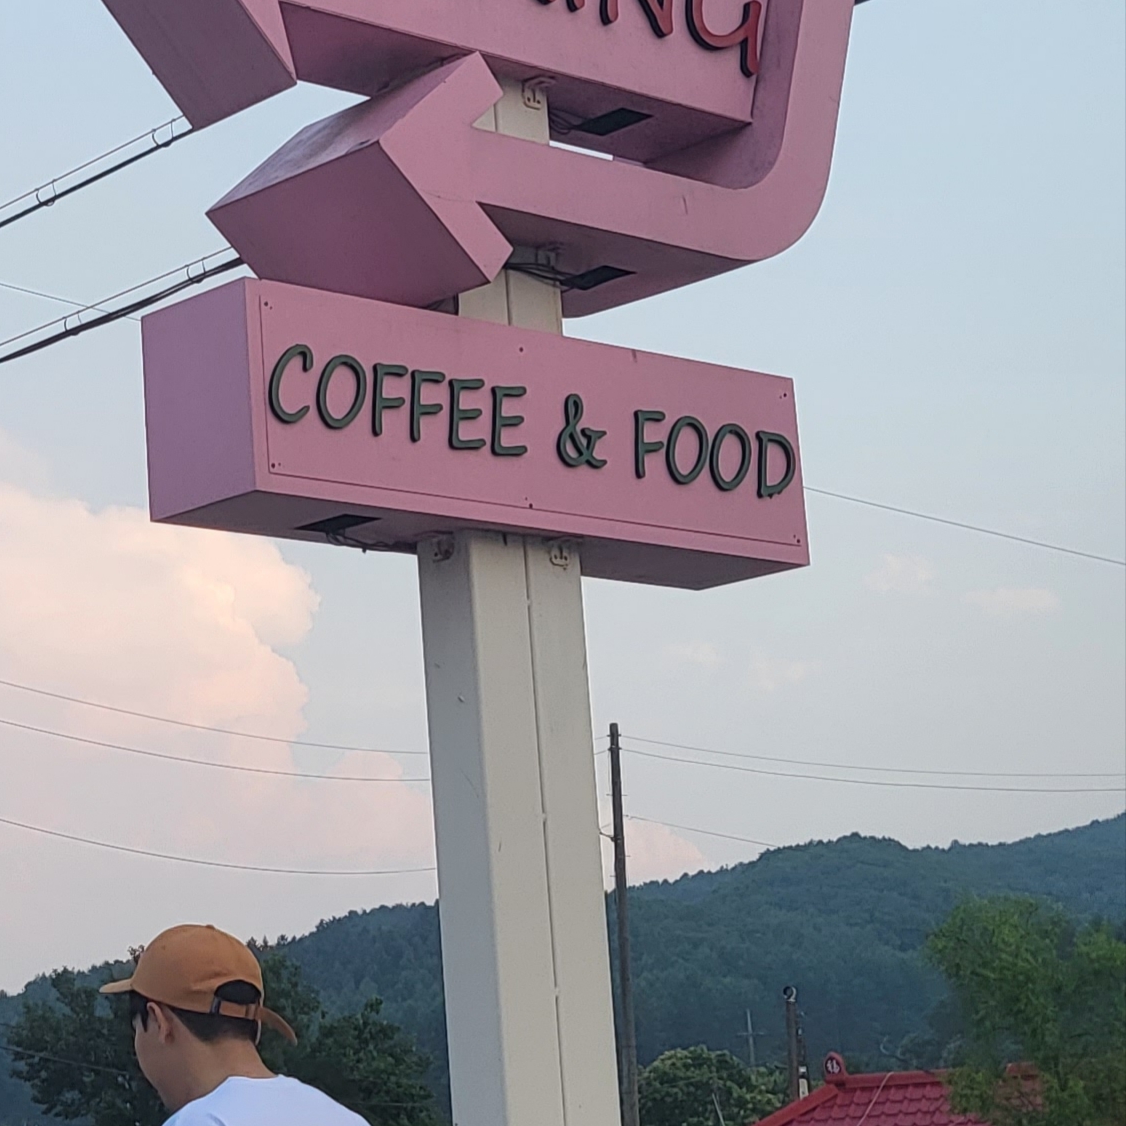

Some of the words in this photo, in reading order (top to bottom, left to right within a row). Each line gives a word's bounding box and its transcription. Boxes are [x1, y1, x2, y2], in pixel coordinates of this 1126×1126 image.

[268, 343, 528, 457] COFFEE
[556, 393, 607, 469] &
[633, 409, 796, 498] FOOD
